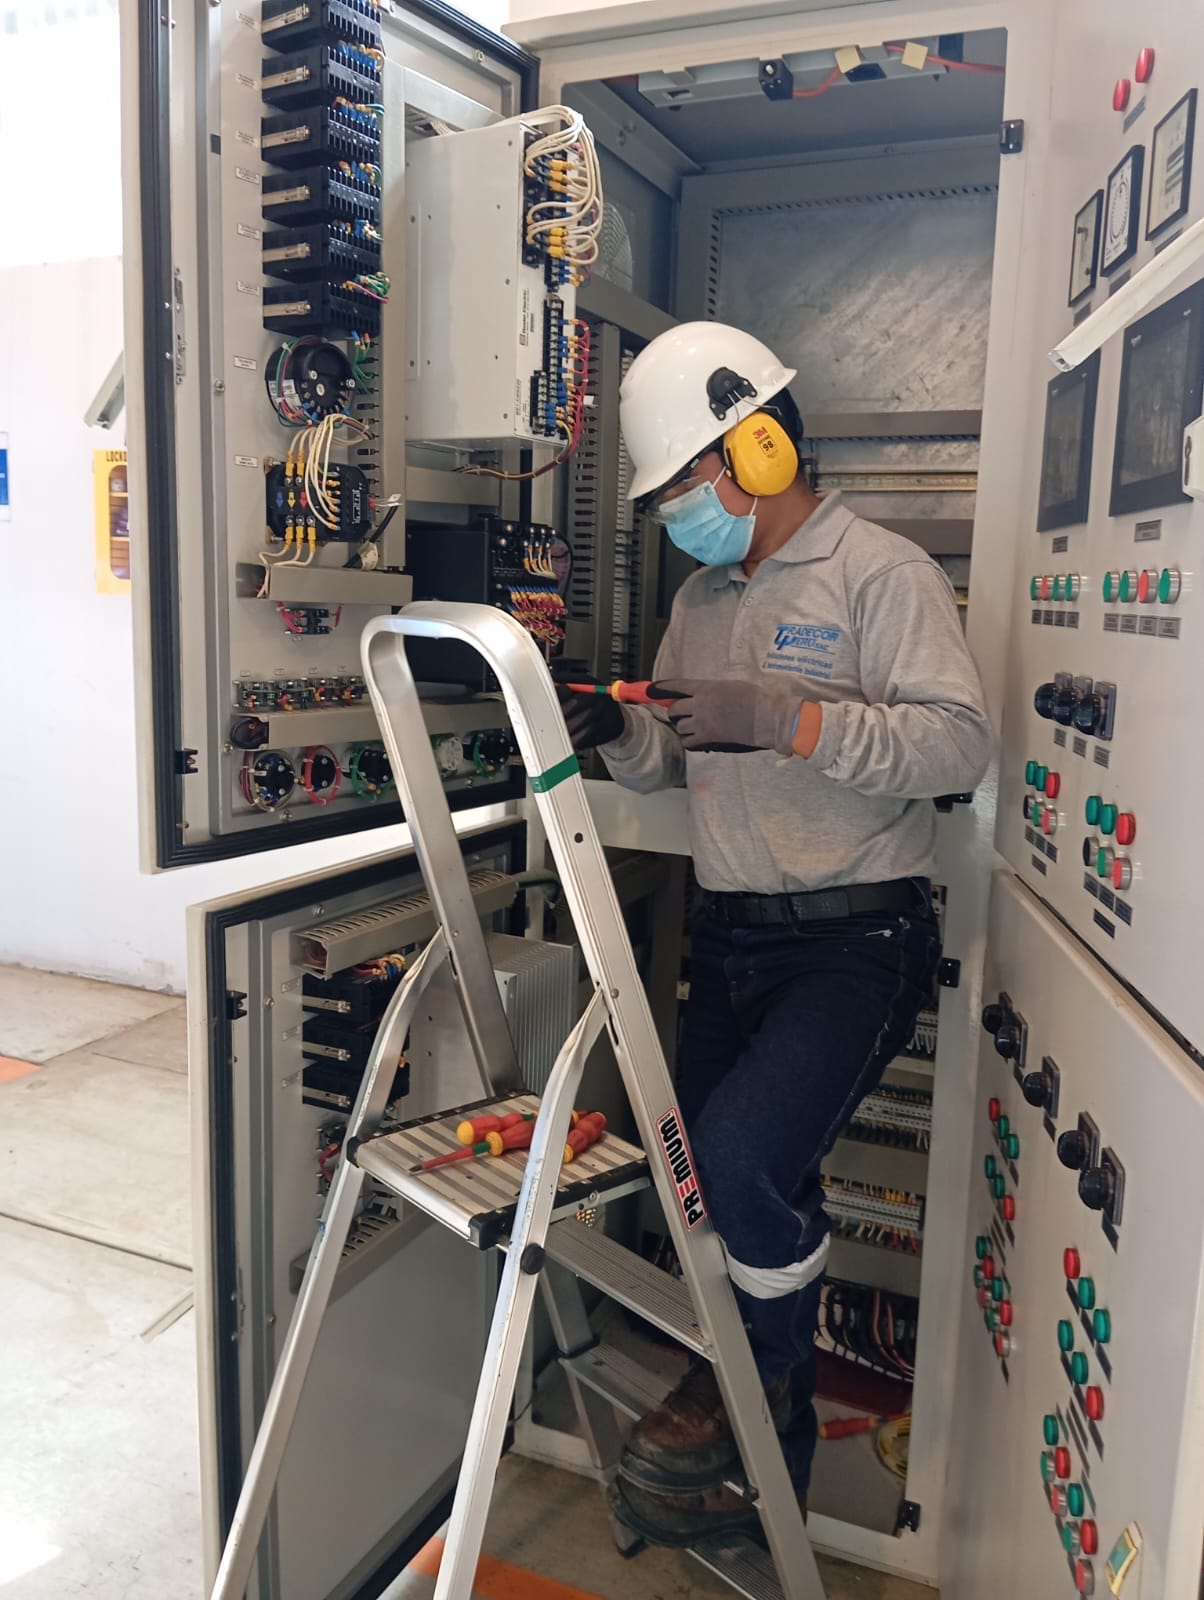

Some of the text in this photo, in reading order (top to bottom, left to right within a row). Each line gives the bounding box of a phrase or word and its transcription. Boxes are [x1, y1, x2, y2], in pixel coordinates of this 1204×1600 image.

[752, 426, 768, 440] 3M
[763, 440, 774, 452] 98
[660, 1115, 704, 1226] PREMIUM
